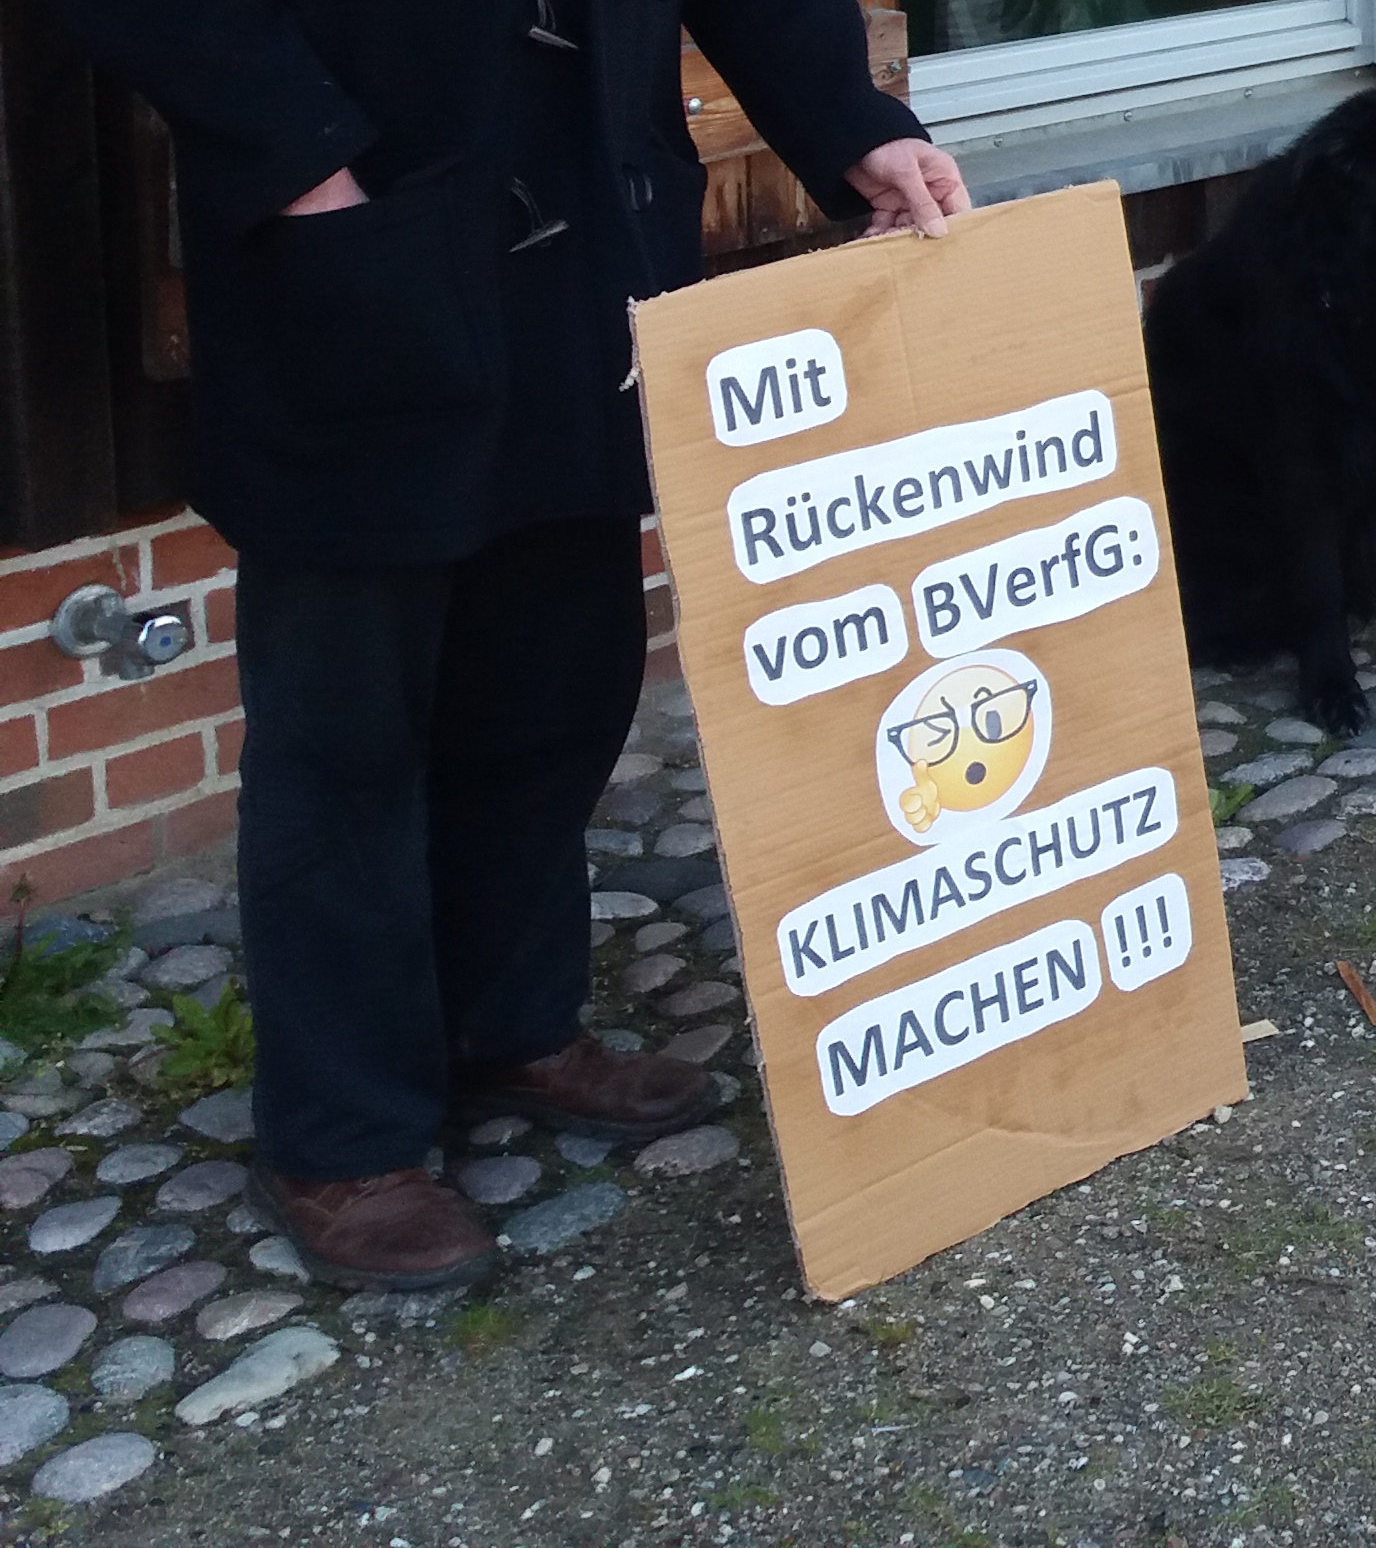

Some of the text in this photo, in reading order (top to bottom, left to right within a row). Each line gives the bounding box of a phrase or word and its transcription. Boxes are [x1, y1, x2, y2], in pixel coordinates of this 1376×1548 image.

[718, 356, 831, 432] Mit
[739, 410, 1104, 566] Rückenwind
[753, 524, 1143, 682] vom BVerfG:
[787, 785, 1161, 979] KLIMASCHUTZ
[826, 895, 1173, 1097] MACHEN !!!
